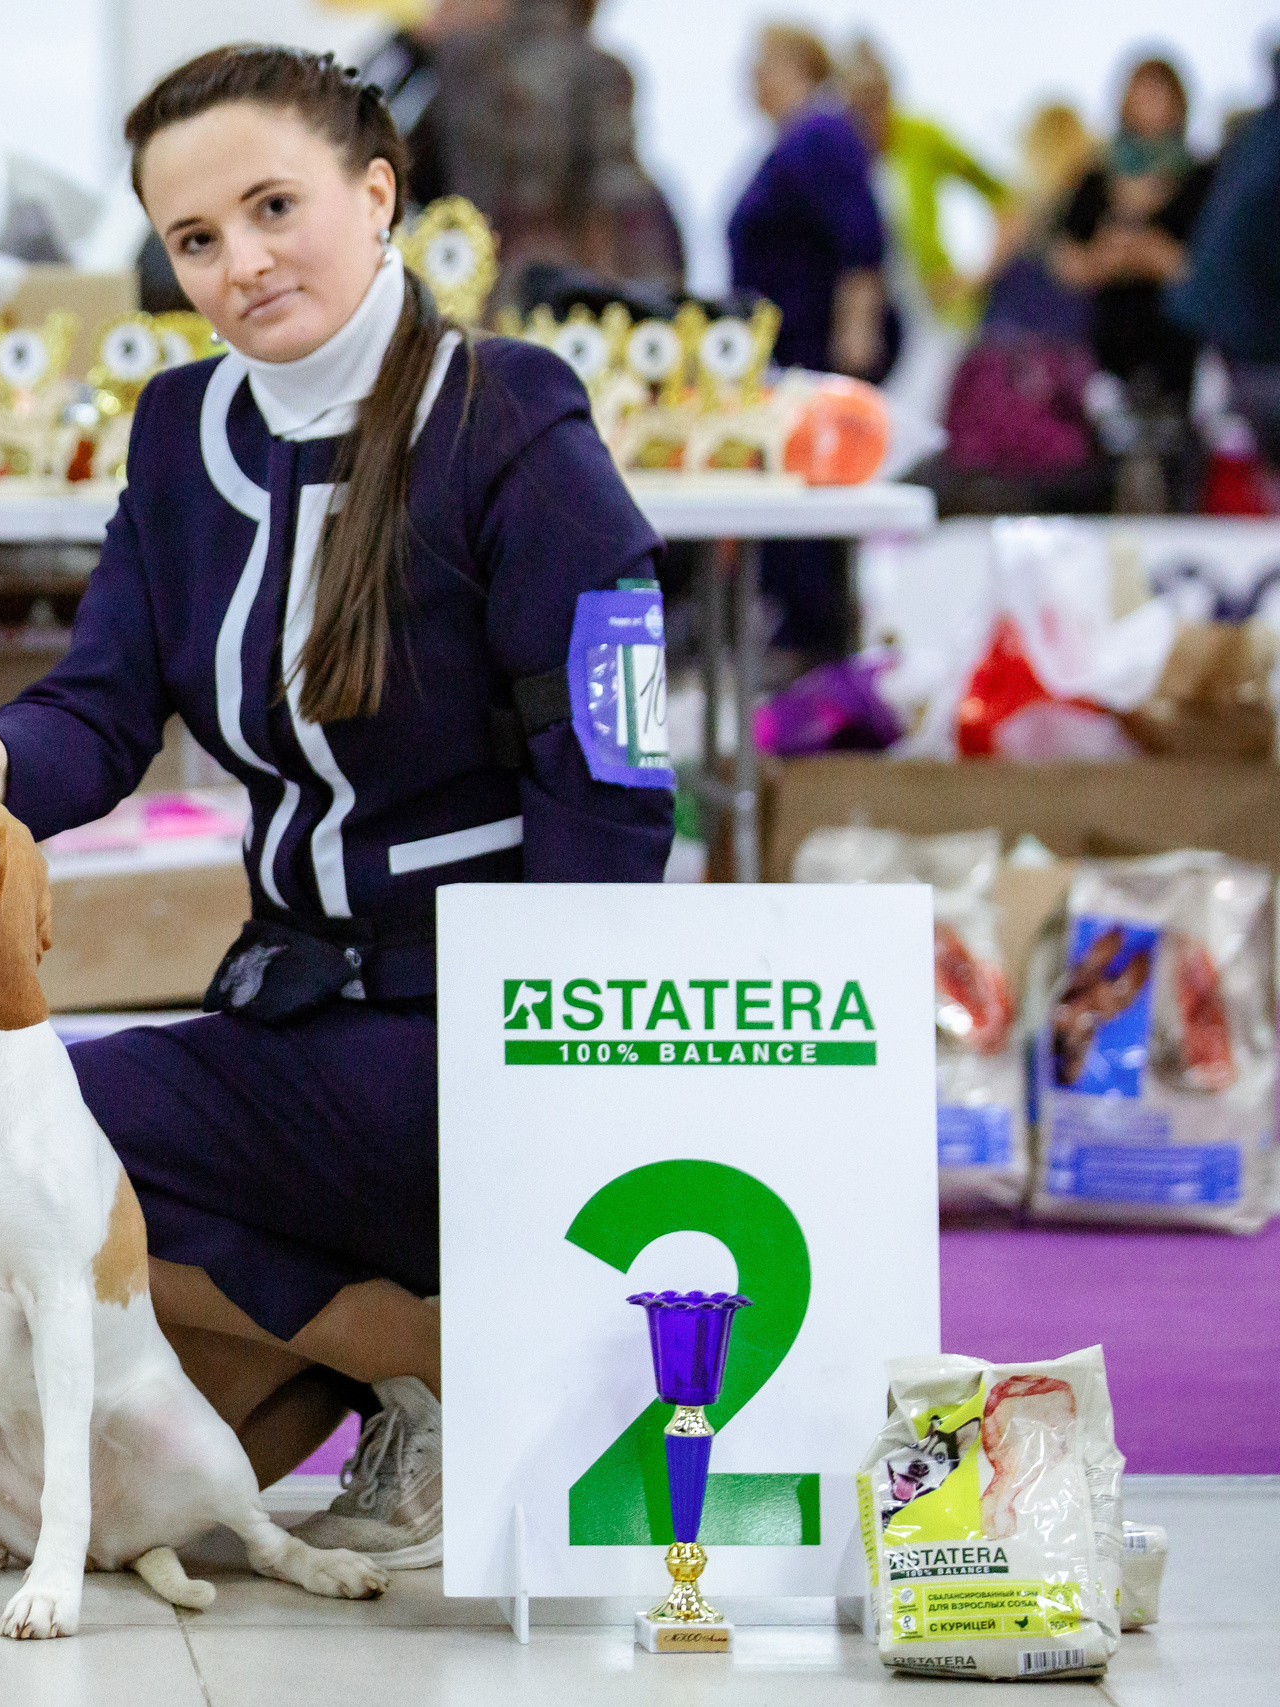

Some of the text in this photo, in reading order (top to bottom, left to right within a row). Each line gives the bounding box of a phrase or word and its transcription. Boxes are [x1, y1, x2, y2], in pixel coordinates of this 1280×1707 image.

[562, 978, 876, 1031] STATERA
[559, 1043, 817, 1064] 100% BALANCE
[564, 1158, 821, 1546] 2
[907, 1547, 1008, 1567] STATERA
[937, 1566, 990, 1576] BALANCE
[927, 1589, 1016, 1601] СБАЛАНСИРОВАННЫЙ
[928, 1603, 948, 1612] ДЛЯ
[951, 1601, 1006, 1610] ВЗРОСЛЫХ
[940, 1619, 996, 1632] КУРИЦЕЙ
[907, 1655, 977, 1666] STATERA
